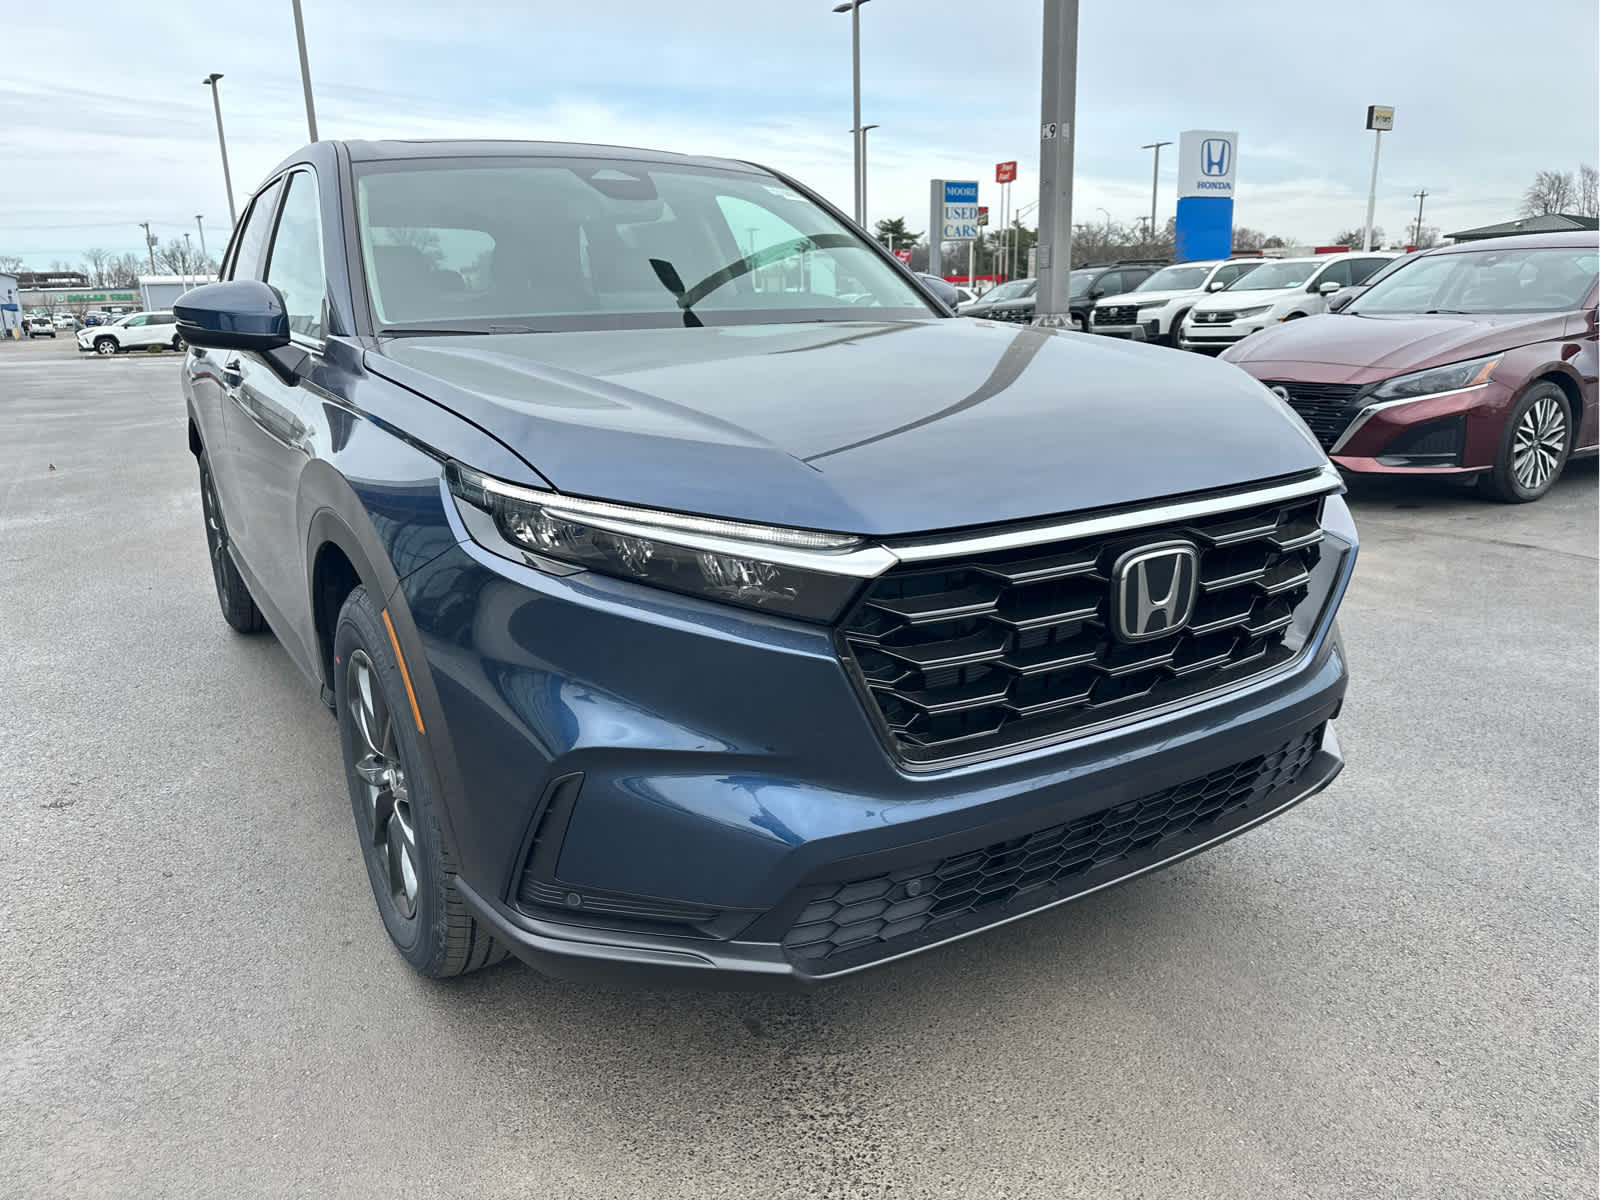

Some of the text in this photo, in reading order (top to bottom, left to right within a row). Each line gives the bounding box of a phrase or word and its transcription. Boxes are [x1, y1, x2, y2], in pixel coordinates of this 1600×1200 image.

[946, 186, 977, 197] MOORE
[1197, 181, 1232, 190] HONDA
[945, 206, 978, 220] USED
[944, 223, 977, 238] CARS
